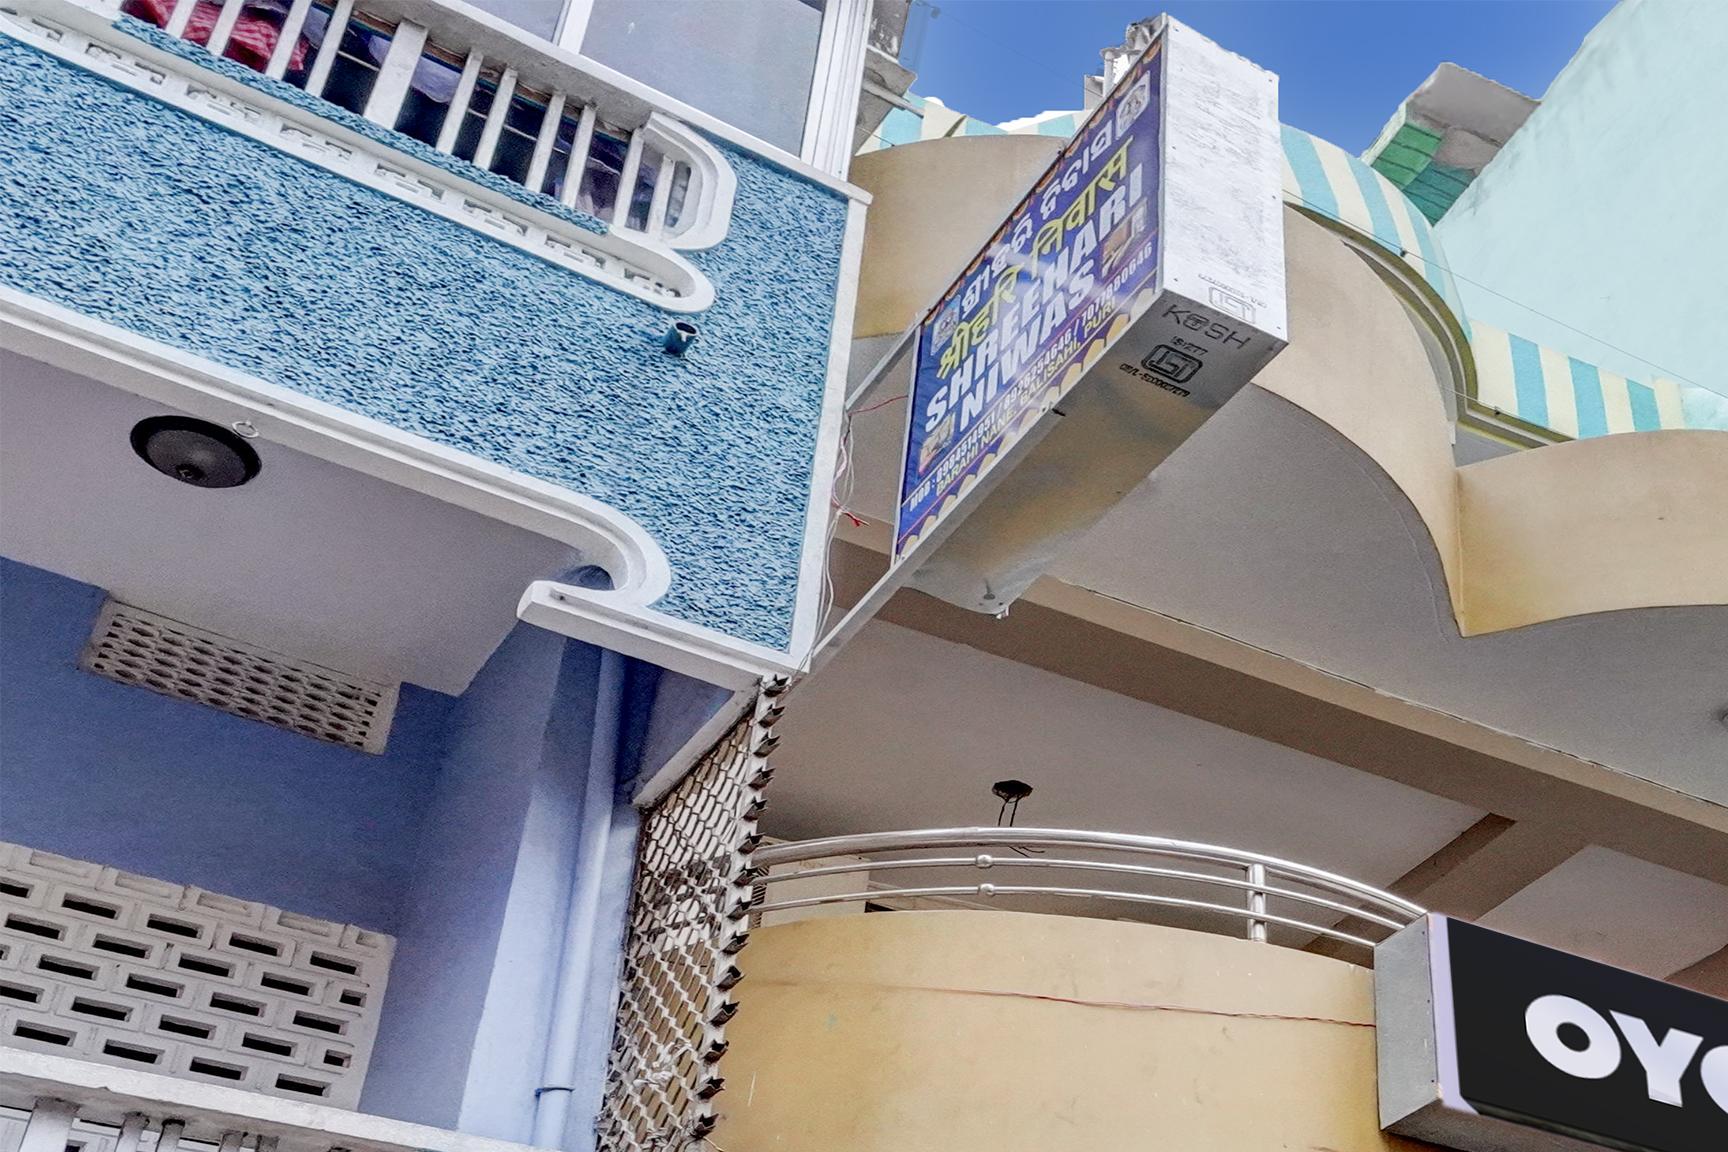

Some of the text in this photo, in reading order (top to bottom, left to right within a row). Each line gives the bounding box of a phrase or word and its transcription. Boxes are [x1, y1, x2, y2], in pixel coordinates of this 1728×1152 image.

[925, 163, 1143, 433] SHREEHARI
[936, 135, 1134, 379] श्रीहरि निवास
[960, 258, 1095, 432] NIWAS
[1084, 295, 1116, 338] PURI
